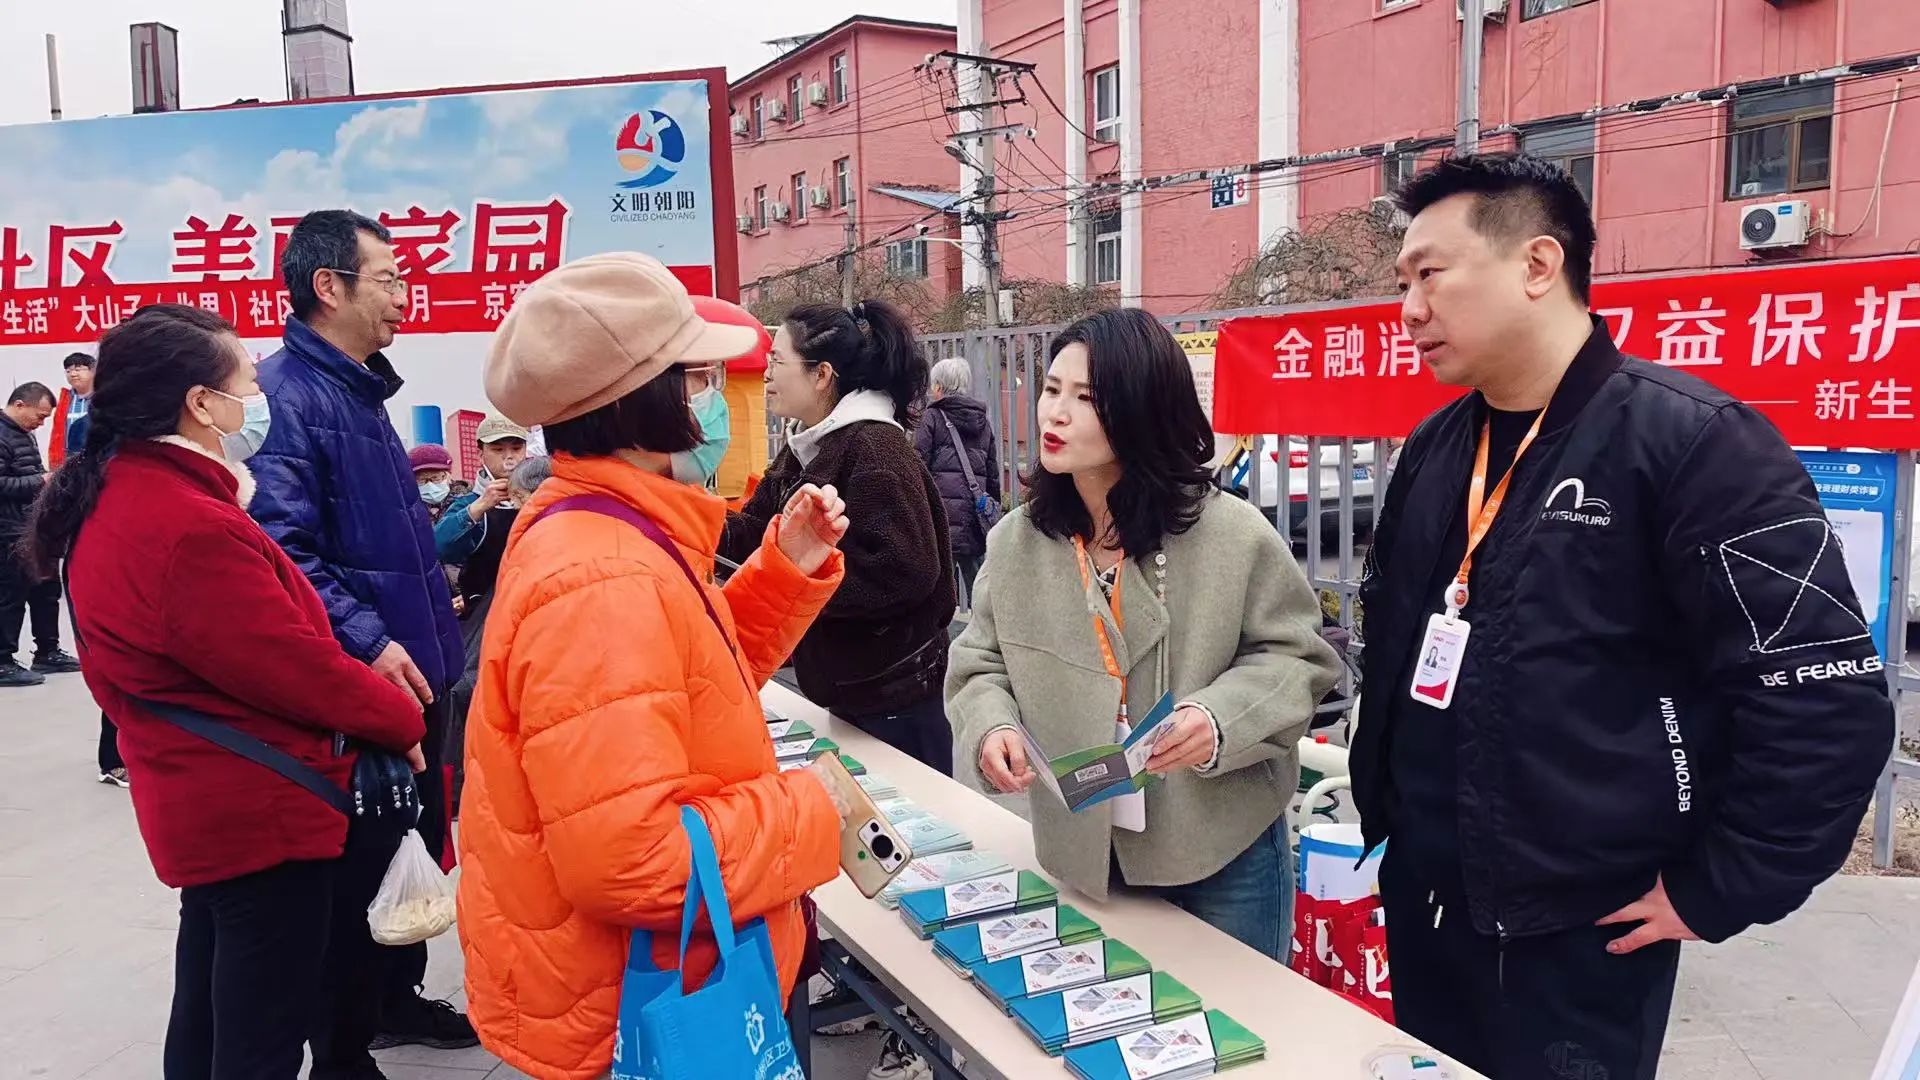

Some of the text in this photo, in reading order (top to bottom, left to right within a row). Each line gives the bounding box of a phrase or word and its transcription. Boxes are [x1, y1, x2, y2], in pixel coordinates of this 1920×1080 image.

[1236, 178, 1246, 198] 8
[609, 191, 695, 212] 文明朝阳
[610, 211, 696, 222] CIVILIZED CHAOYANG
[1272, 321, 1421, 379] 金融消
[1759, 671, 1789, 687] BE
[1659, 697, 1691, 813] BEYOND DENIM
